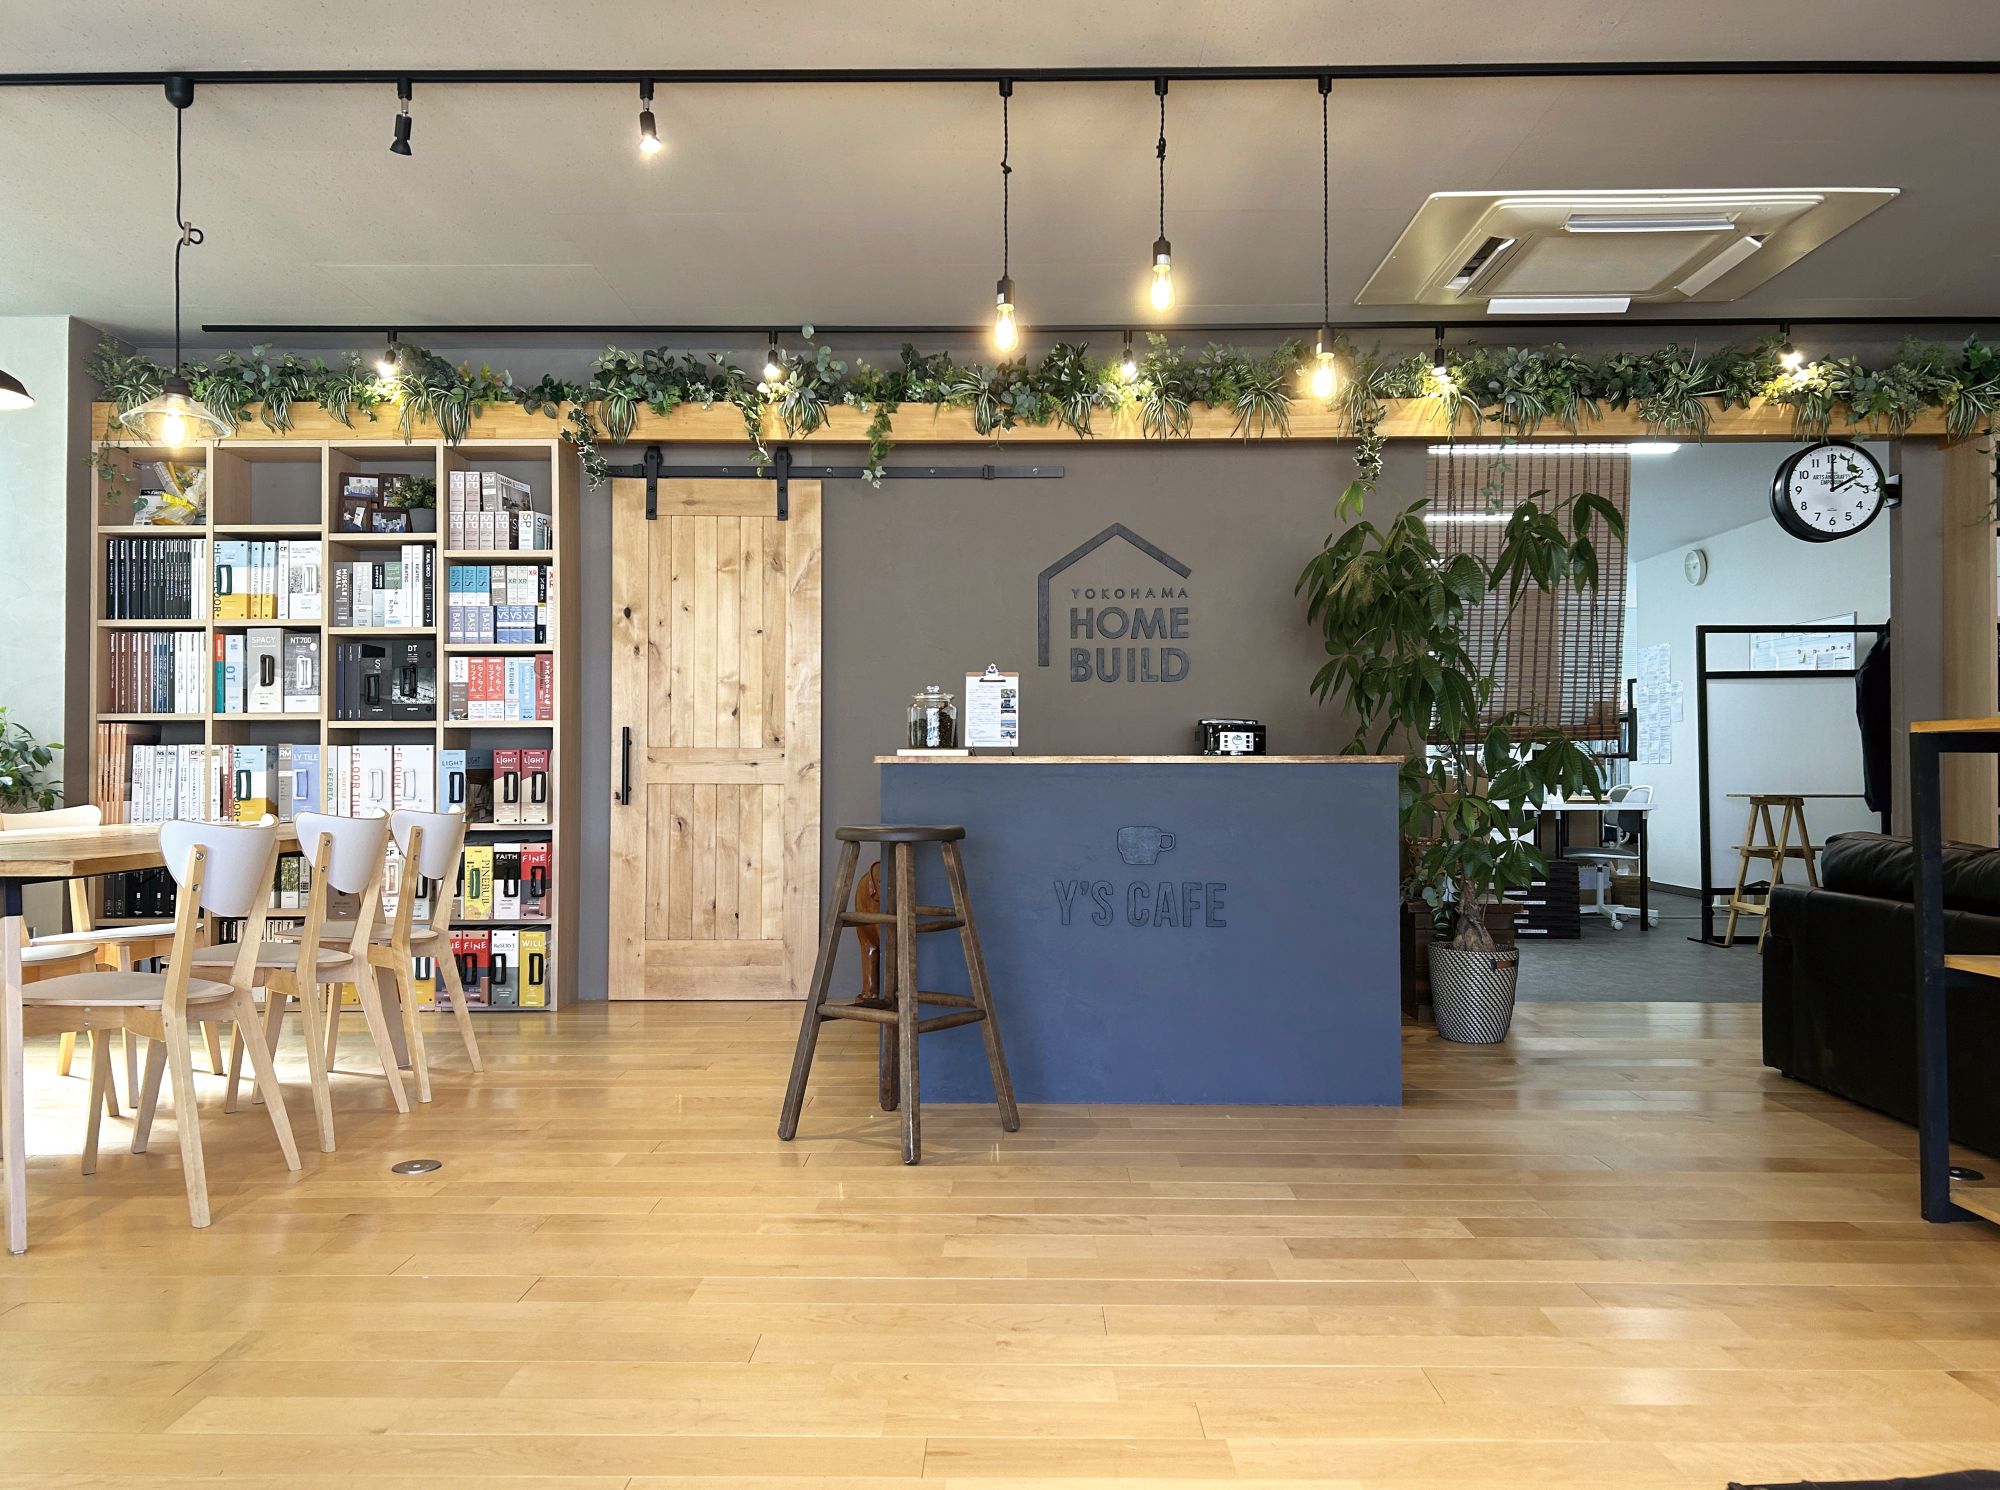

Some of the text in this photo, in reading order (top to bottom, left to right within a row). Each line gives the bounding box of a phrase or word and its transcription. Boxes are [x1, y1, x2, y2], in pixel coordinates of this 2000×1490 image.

[1812, 459, 1819, 468] 11
[1799, 471, 1809, 479] 10
[1795, 486, 1802, 495] 9
[1801, 502, 1807, 510] 8
[1856, 501, 1863, 509] 4
[1814, 513, 1821, 521] 7
[1845, 512, 1852, 520] 5
[1829, 517, 1836, 525] 6
[1072, 588, 1188, 600] YOKOHAMA
[1070, 606, 1189, 639] HOME
[375, 659, 380, 668] S
[1070, 648, 1190, 682] BUILD
[496, 756, 516, 765] LIGHT
[524, 756, 544, 765] LIGHT
[352, 753, 360, 816] FLOOR TILE
[522, 854, 545, 863] FINE
[1053, 880, 1226, 927] Y'S CAFE
